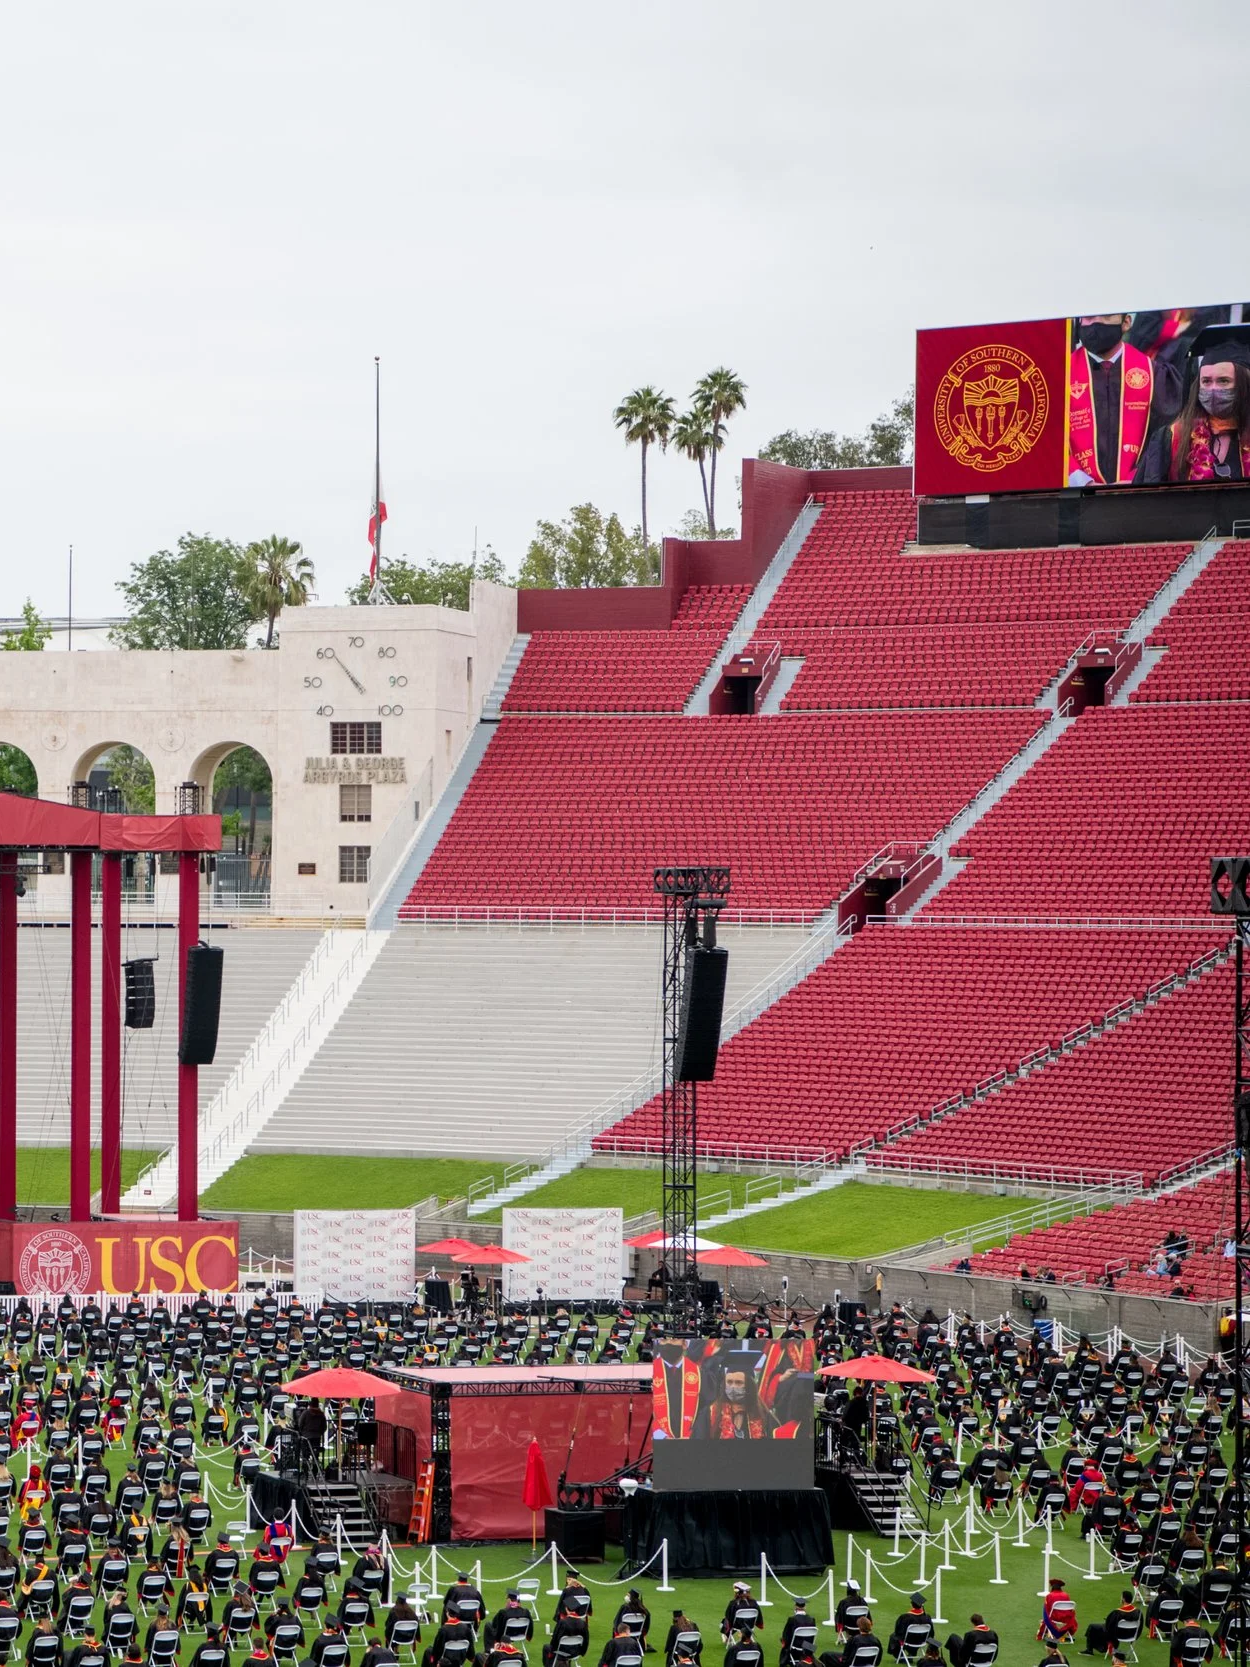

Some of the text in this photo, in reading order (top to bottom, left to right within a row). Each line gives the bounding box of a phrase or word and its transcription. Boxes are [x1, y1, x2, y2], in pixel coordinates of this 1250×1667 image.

[984, 364, 1000, 372] 1880
[937, 380, 952, 443] UNIVERSITY
[956, 360, 969, 372] OF
[970, 348, 1027, 366] SOUTHERN
[1031, 372, 1046, 438] CALIFORNIA
[348, 636, 364, 648] 70
[316, 648, 335, 660] 60
[378, 647, 396, 658] 80
[304, 676, 322, 688] 50
[389, 676, 408, 688] 90
[316, 705, 334, 717] 40
[378, 704, 403, 716] 100
[305, 757, 406, 770] JULIA & GEORGE
[303, 772, 408, 784] ARGYROS PLAZA
[22, 1232, 89, 1290] UNIVERSITY OF SOUTHERN CALIFORNIA
[95, 1236, 237, 1294] USC
